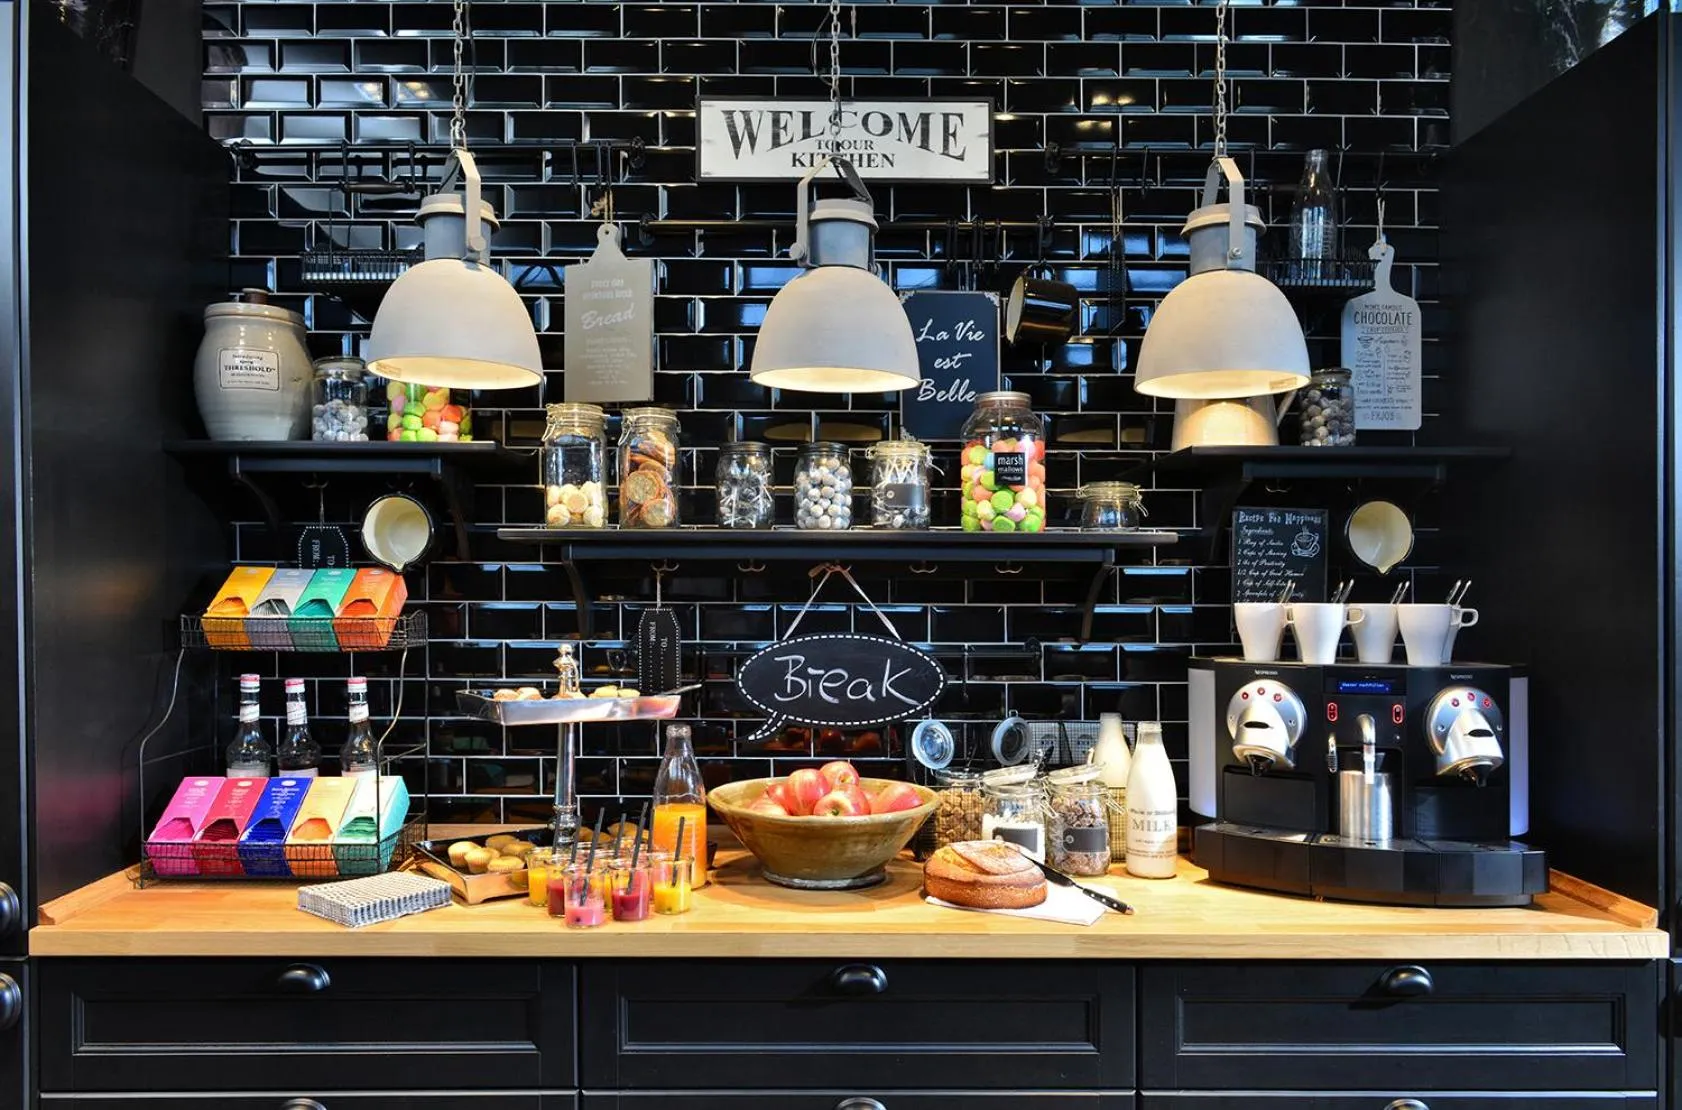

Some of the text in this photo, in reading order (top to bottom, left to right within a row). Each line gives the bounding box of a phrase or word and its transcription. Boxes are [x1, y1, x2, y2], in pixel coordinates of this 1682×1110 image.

[721, 110, 966, 162] WELCOME
[840, 139, 874, 151] OUR
[581, 302, 635, 330] Bread
[1354, 311, 1413, 326] CHOCOLATE
[916, 318, 985, 342] La Vie
[934, 353, 972, 369] est
[917, 379, 977, 402] Belle
[998, 454, 1024, 465] marsh
[774, 654, 922, 706] Break
[1131, 818, 1174, 833] MILK
